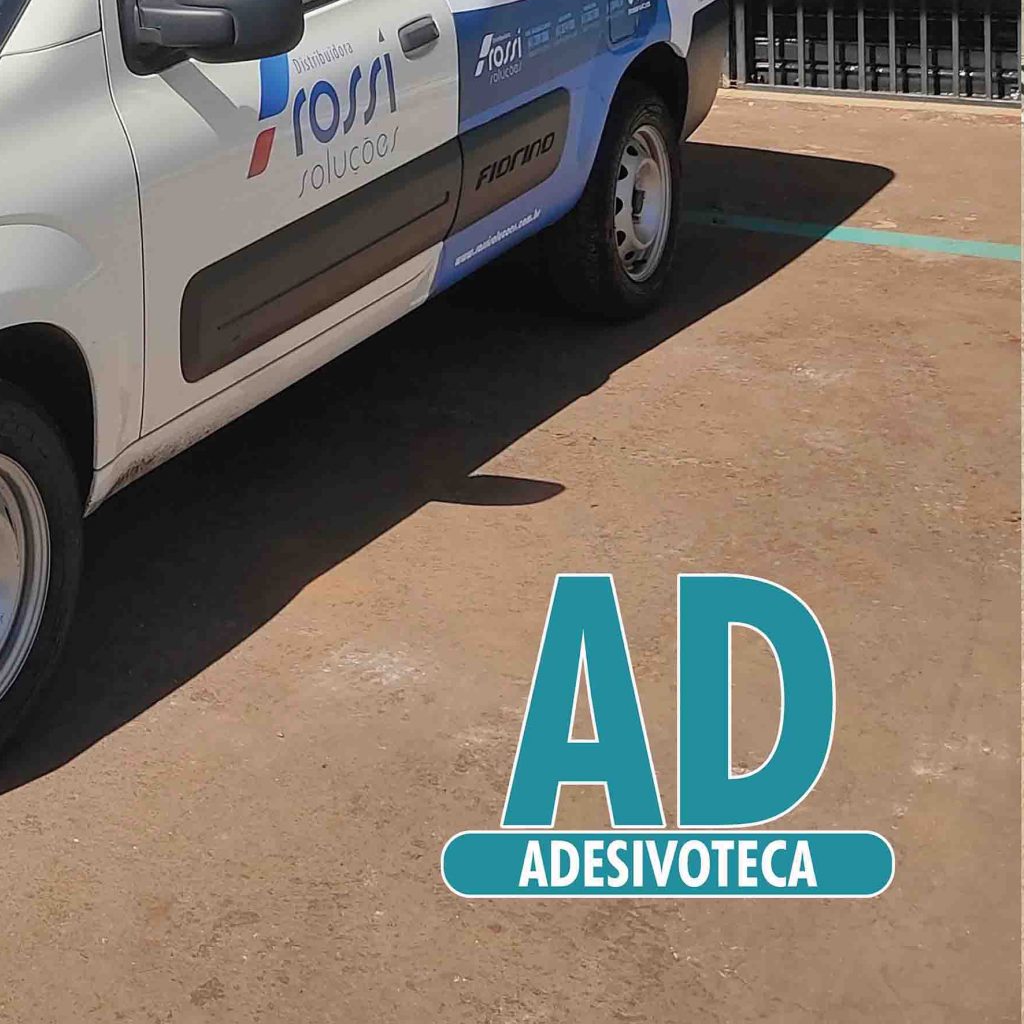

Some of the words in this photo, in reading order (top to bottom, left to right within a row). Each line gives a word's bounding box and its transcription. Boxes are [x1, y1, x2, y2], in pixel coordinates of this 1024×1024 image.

[292, 41, 354, 74] Distribuidora
[292, 28, 397, 157] rossi
[298, 126, 399, 198] soluções
